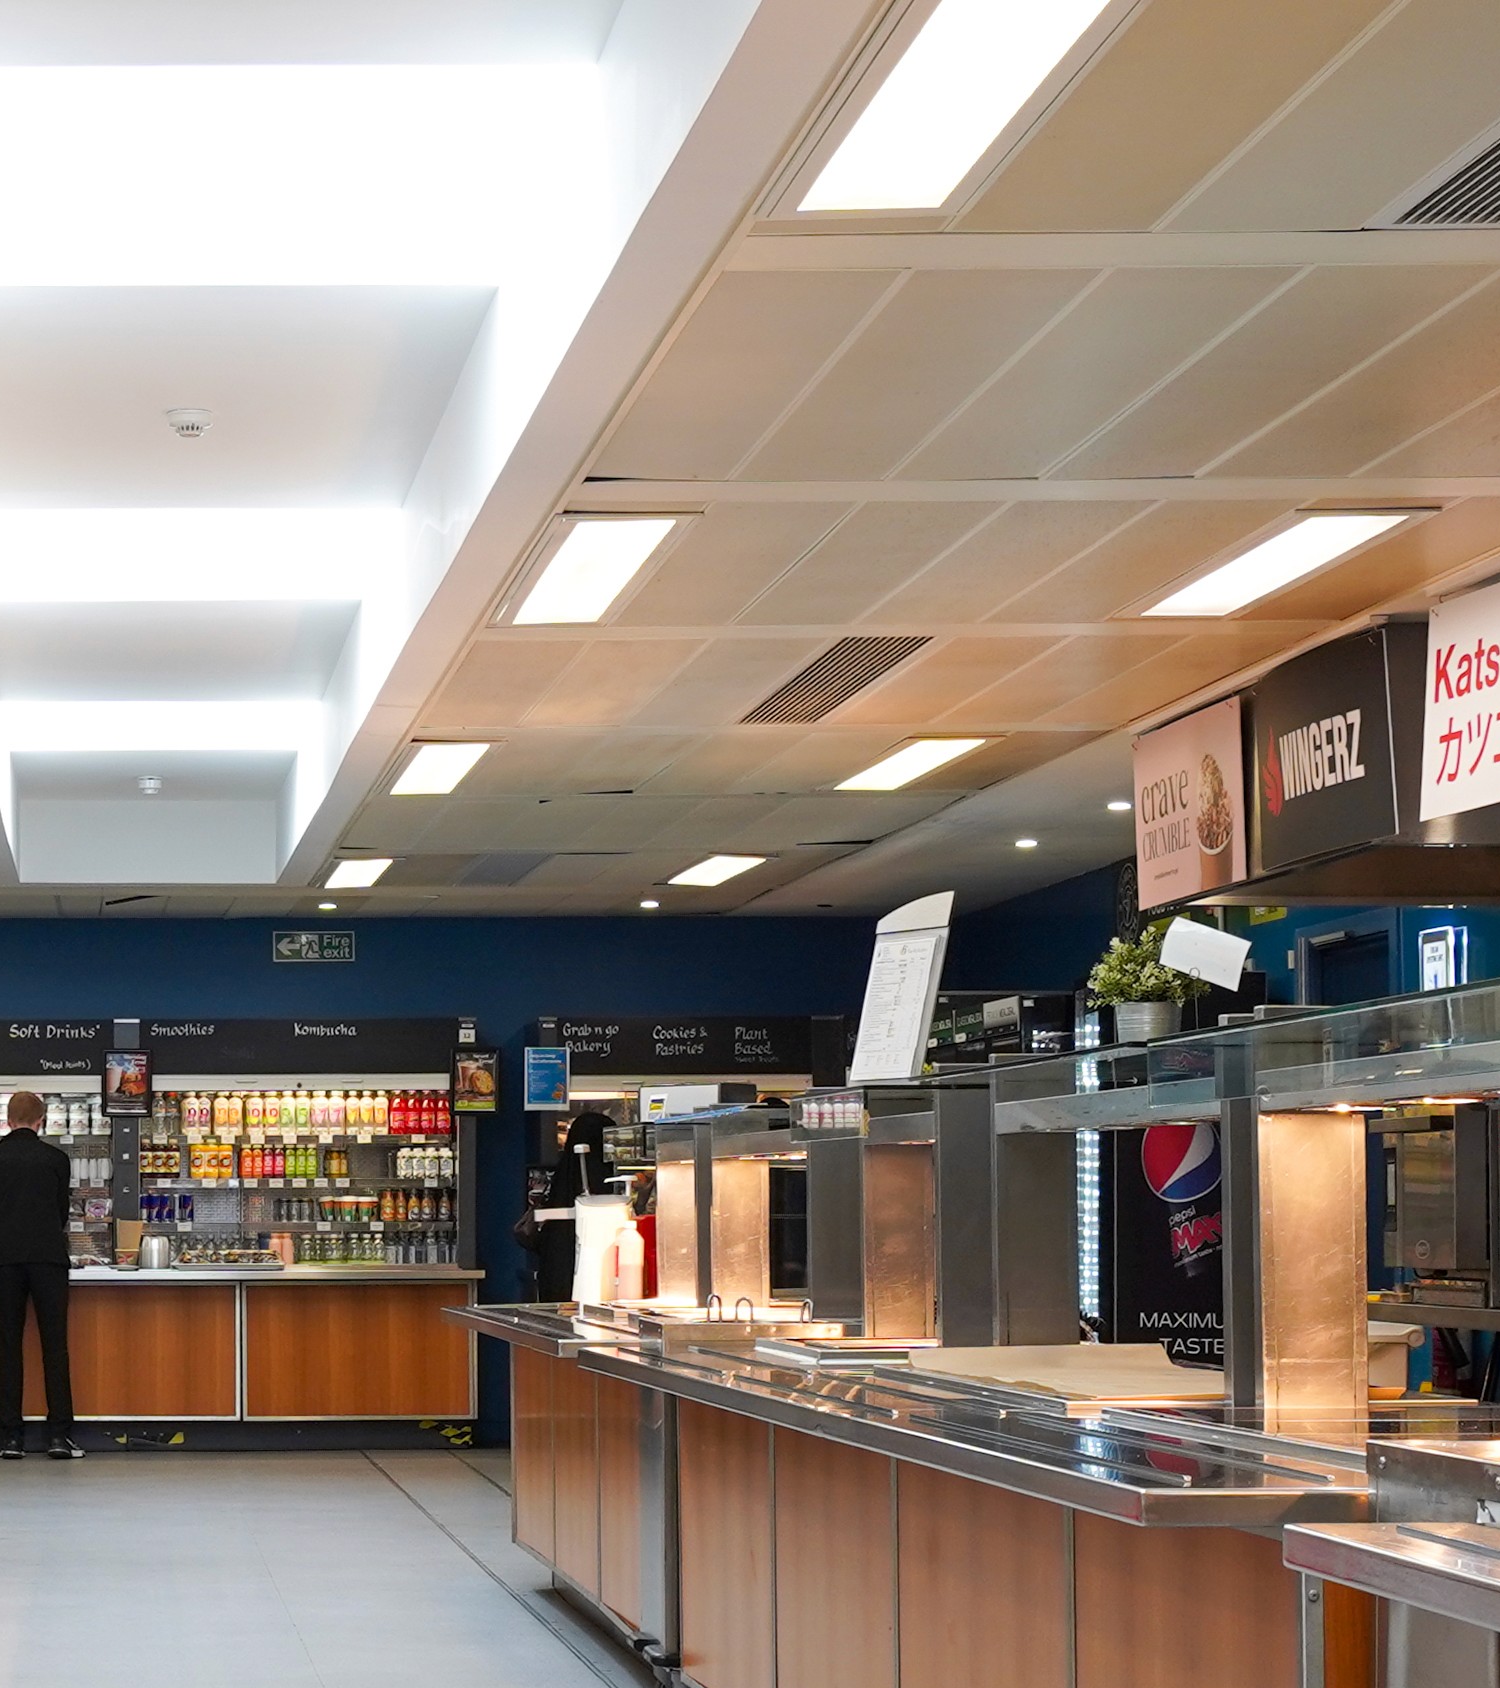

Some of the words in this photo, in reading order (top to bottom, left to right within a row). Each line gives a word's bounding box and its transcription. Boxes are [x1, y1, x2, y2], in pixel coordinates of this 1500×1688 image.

[1279, 708, 1365, 801] WINGERZ
[1142, 769, 1189, 824] crave
[1142, 817, 1191, 863] CRUMBLE
[323, 935, 350, 948] Fire
[323, 946, 350, 959] exit
[9, 1024, 40, 1038] Soft
[151, 1023, 215, 1037] Smoothies
[293, 1023, 358, 1038] Kombucha
[562, 1023, 592, 1037] Grab
[594, 1026, 602, 1036] n
[604, 1025, 620, 1040] go
[652, 1026, 697, 1040] Cookies
[734, 1026, 768, 1040] Plant
[565, 1040, 612, 1057] Bakery
[655, 1042, 704, 1056] Pastries
[734, 1041, 773, 1055] Based
[1168, 1205, 1196, 1228] pepsi
[1172, 1211, 1222, 1258] MAX
[1139, 1312, 1224, 1329] MAXIMU
[1159, 1338, 1224, 1354] TASTE
